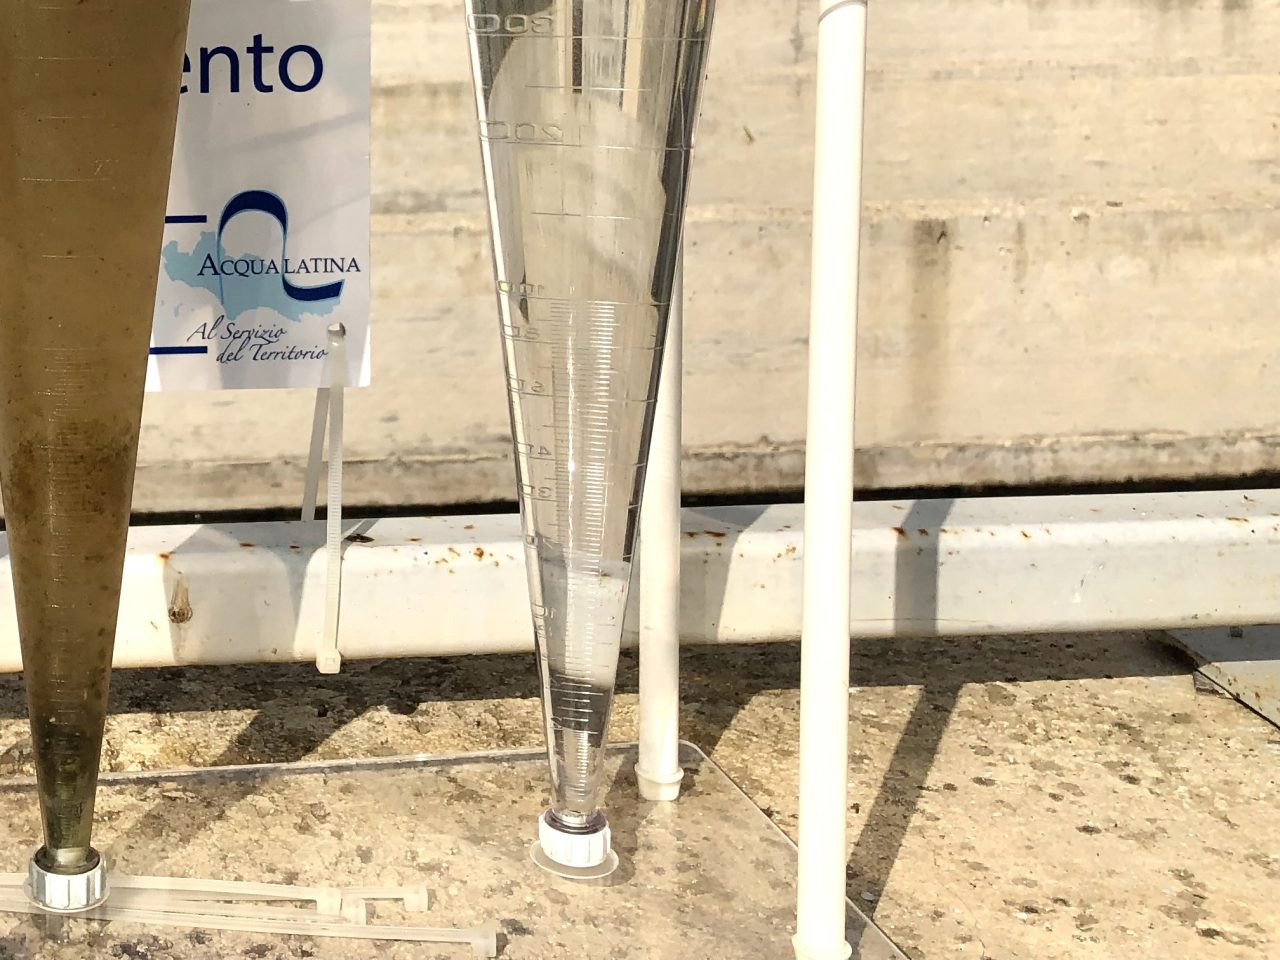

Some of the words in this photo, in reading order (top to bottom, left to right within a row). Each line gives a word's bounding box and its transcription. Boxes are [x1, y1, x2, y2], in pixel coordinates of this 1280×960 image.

[187, 315, 225, 342] Al
[221, 322, 287, 344] Servizio
[216, 335, 251, 363] del
[249, 342, 328, 362] Territorio
